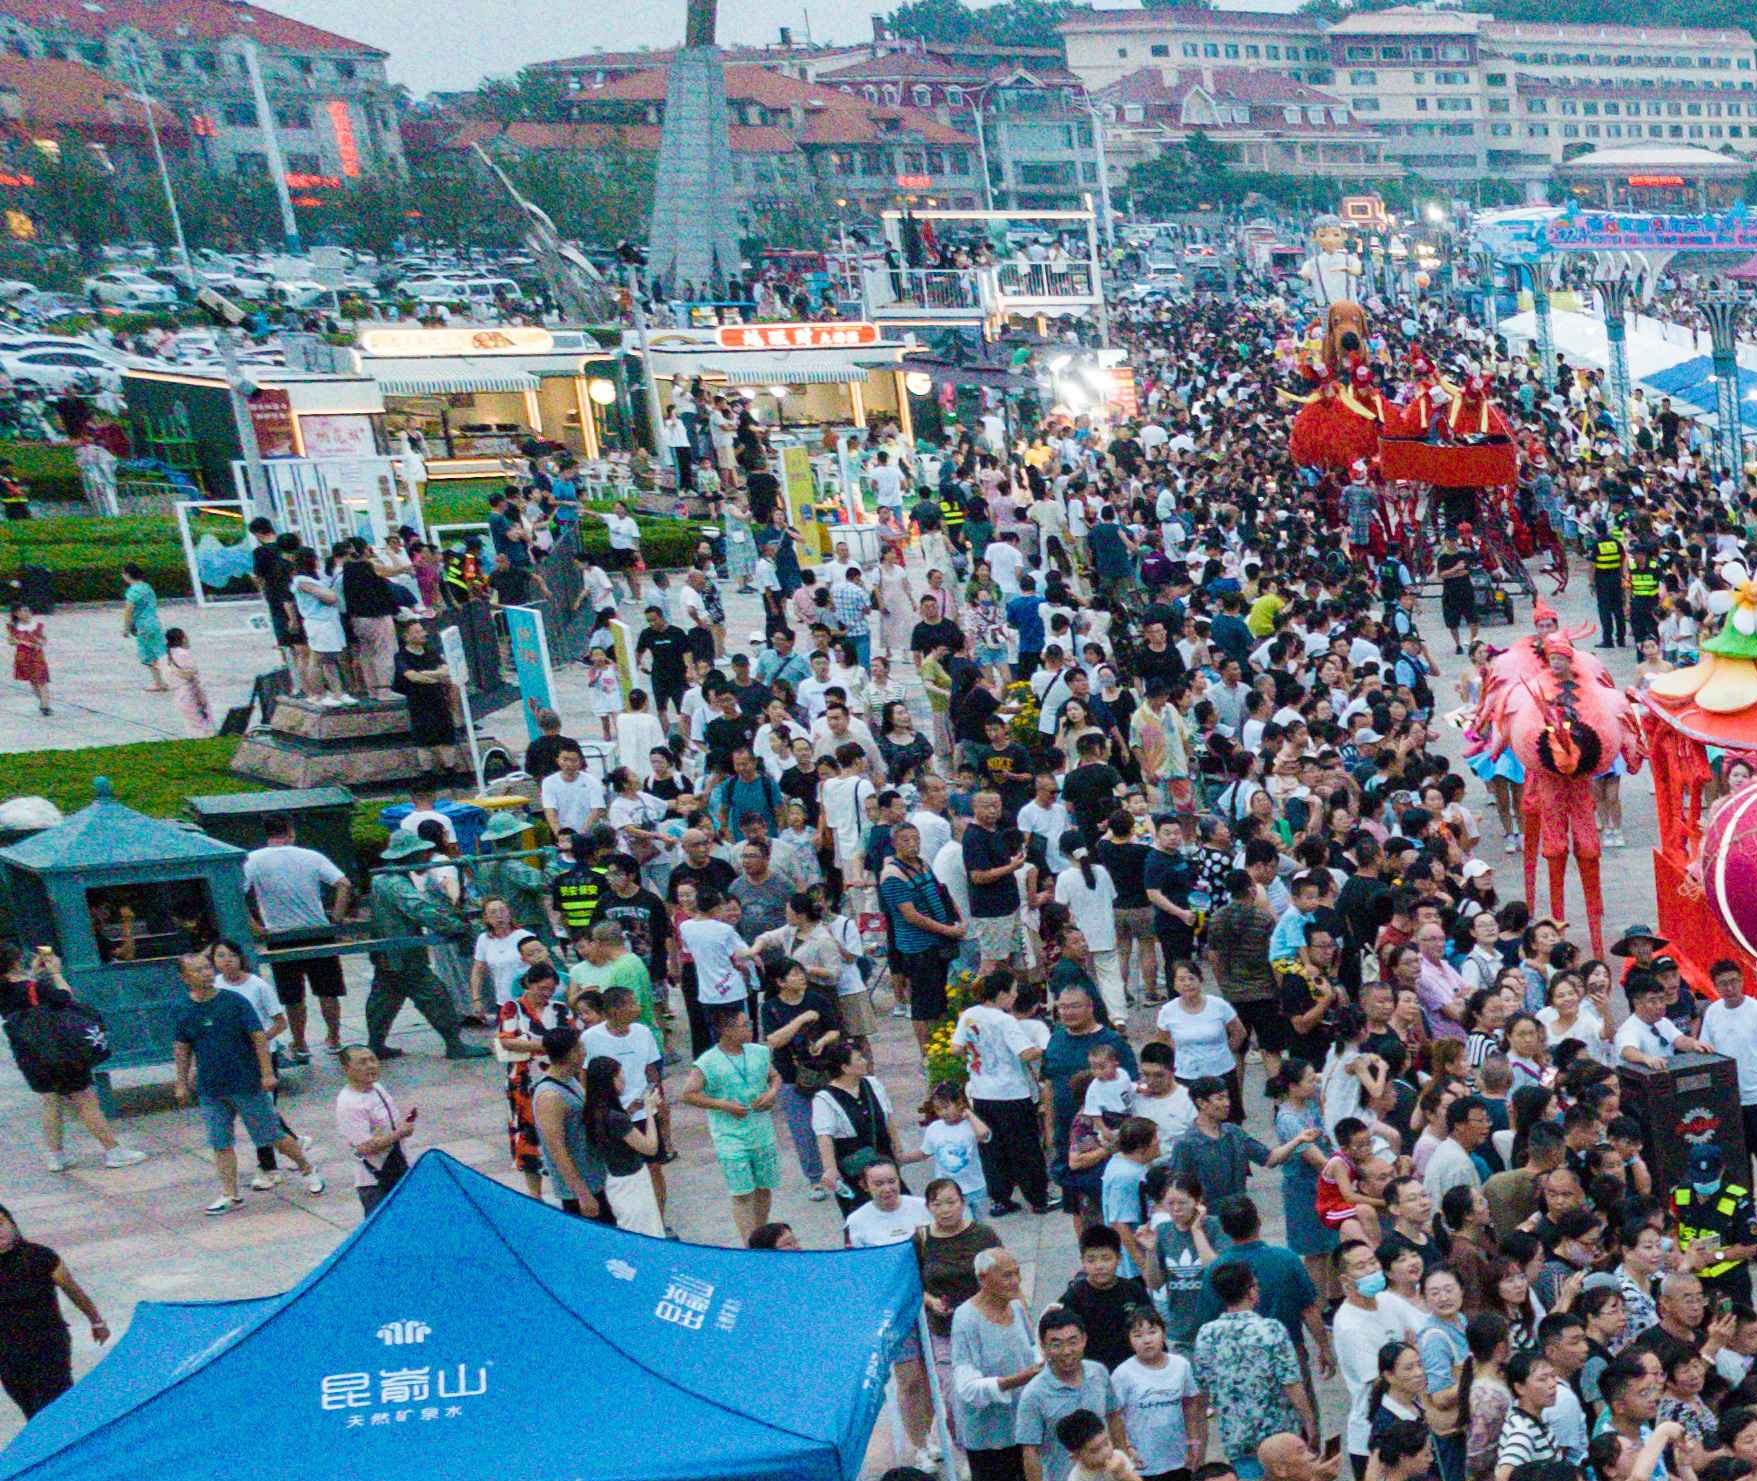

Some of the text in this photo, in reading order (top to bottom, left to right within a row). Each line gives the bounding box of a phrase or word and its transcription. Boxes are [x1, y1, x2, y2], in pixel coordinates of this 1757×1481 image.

[346, 1405, 464, 1429] 天然矿泉水
